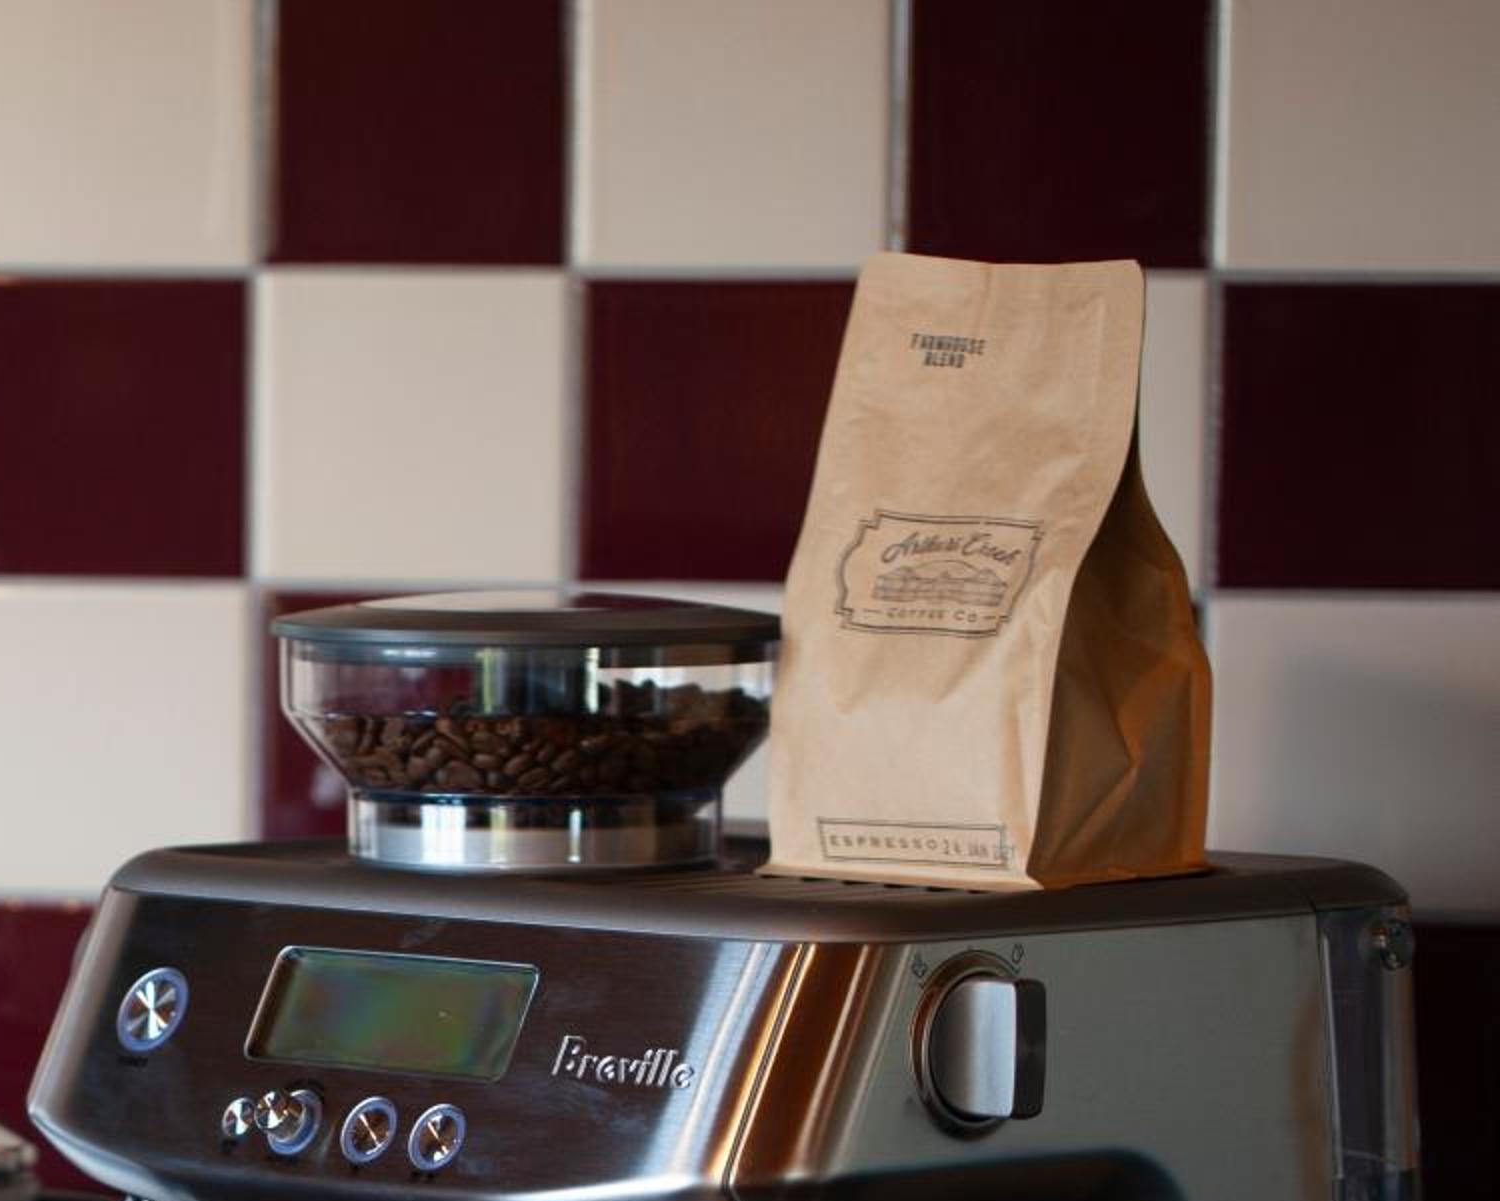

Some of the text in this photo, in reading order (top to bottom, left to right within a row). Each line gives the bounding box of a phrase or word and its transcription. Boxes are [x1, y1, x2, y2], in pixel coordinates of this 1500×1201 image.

[924, 351, 965, 368] BLEND
[829, 835, 938, 850] ESPRESSO
[552, 1035, 695, 1088] Breville
